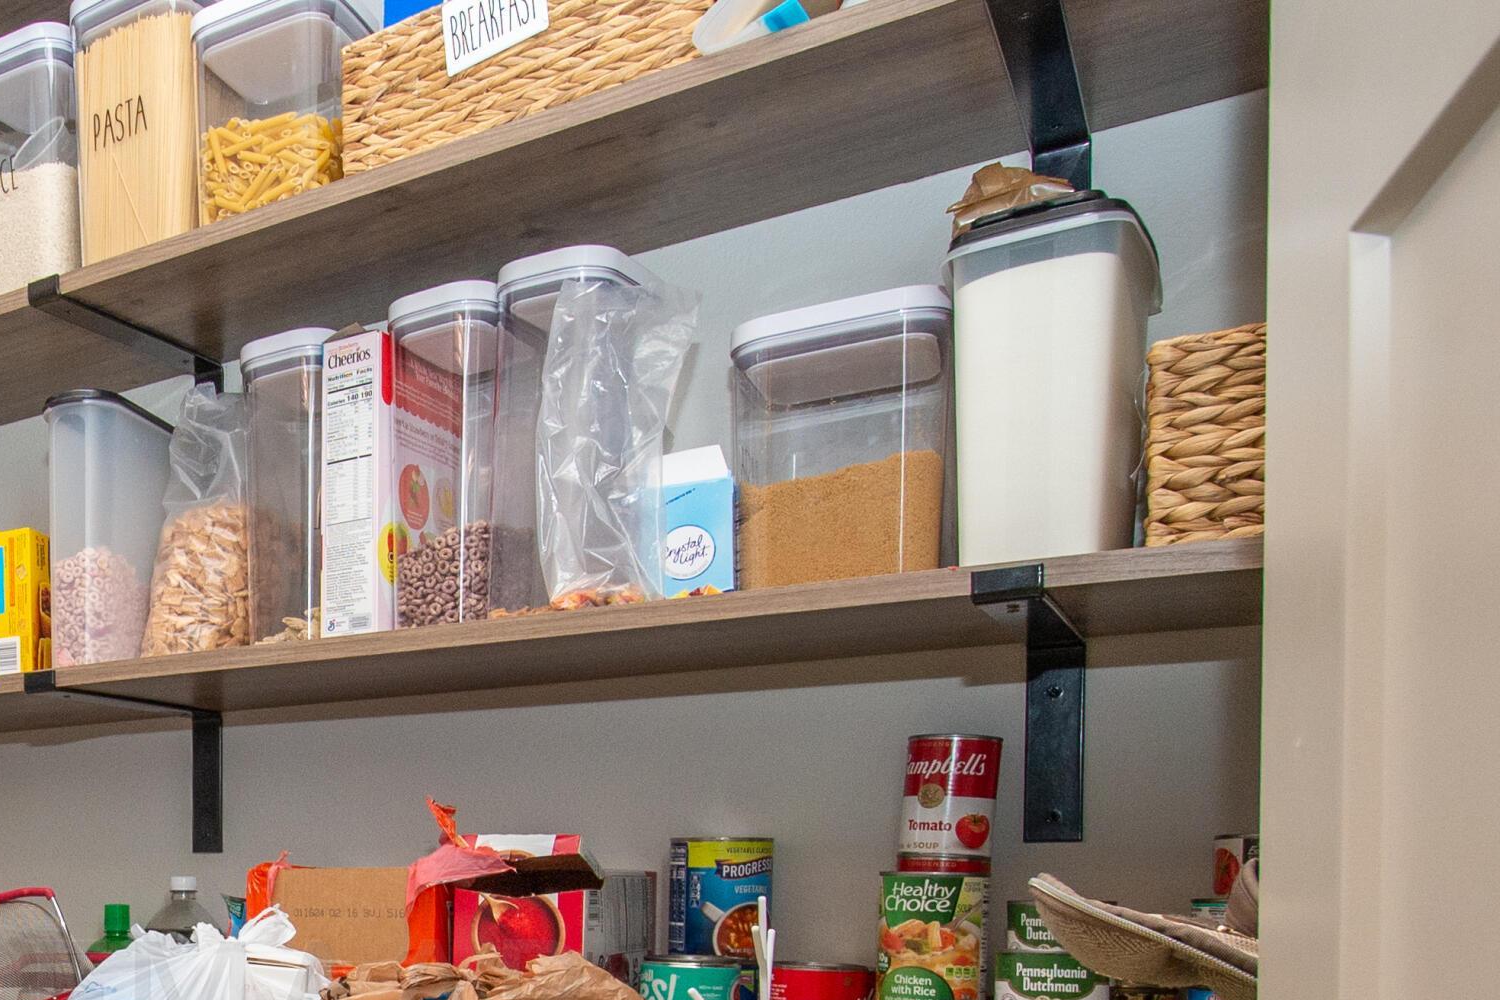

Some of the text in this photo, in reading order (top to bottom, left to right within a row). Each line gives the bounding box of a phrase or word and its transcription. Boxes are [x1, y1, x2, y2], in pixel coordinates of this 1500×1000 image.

[92, 94, 148, 152] PASTA
[328, 348, 371, 369] Cheerios
[328, 372, 353, 382] Nutrition
[908, 819, 952, 832] Tomato
[722, 859, 773, 878] PROGRESS
[892, 879, 956, 900] Healthy
[885, 894, 951, 912] Choice
[1016, 963, 1088, 980] Pennsylvania
[894, 975, 932, 986] Chicken
[1023, 977, 1080, 993] Dutchman
[891, 986, 936, 996] with Rice
